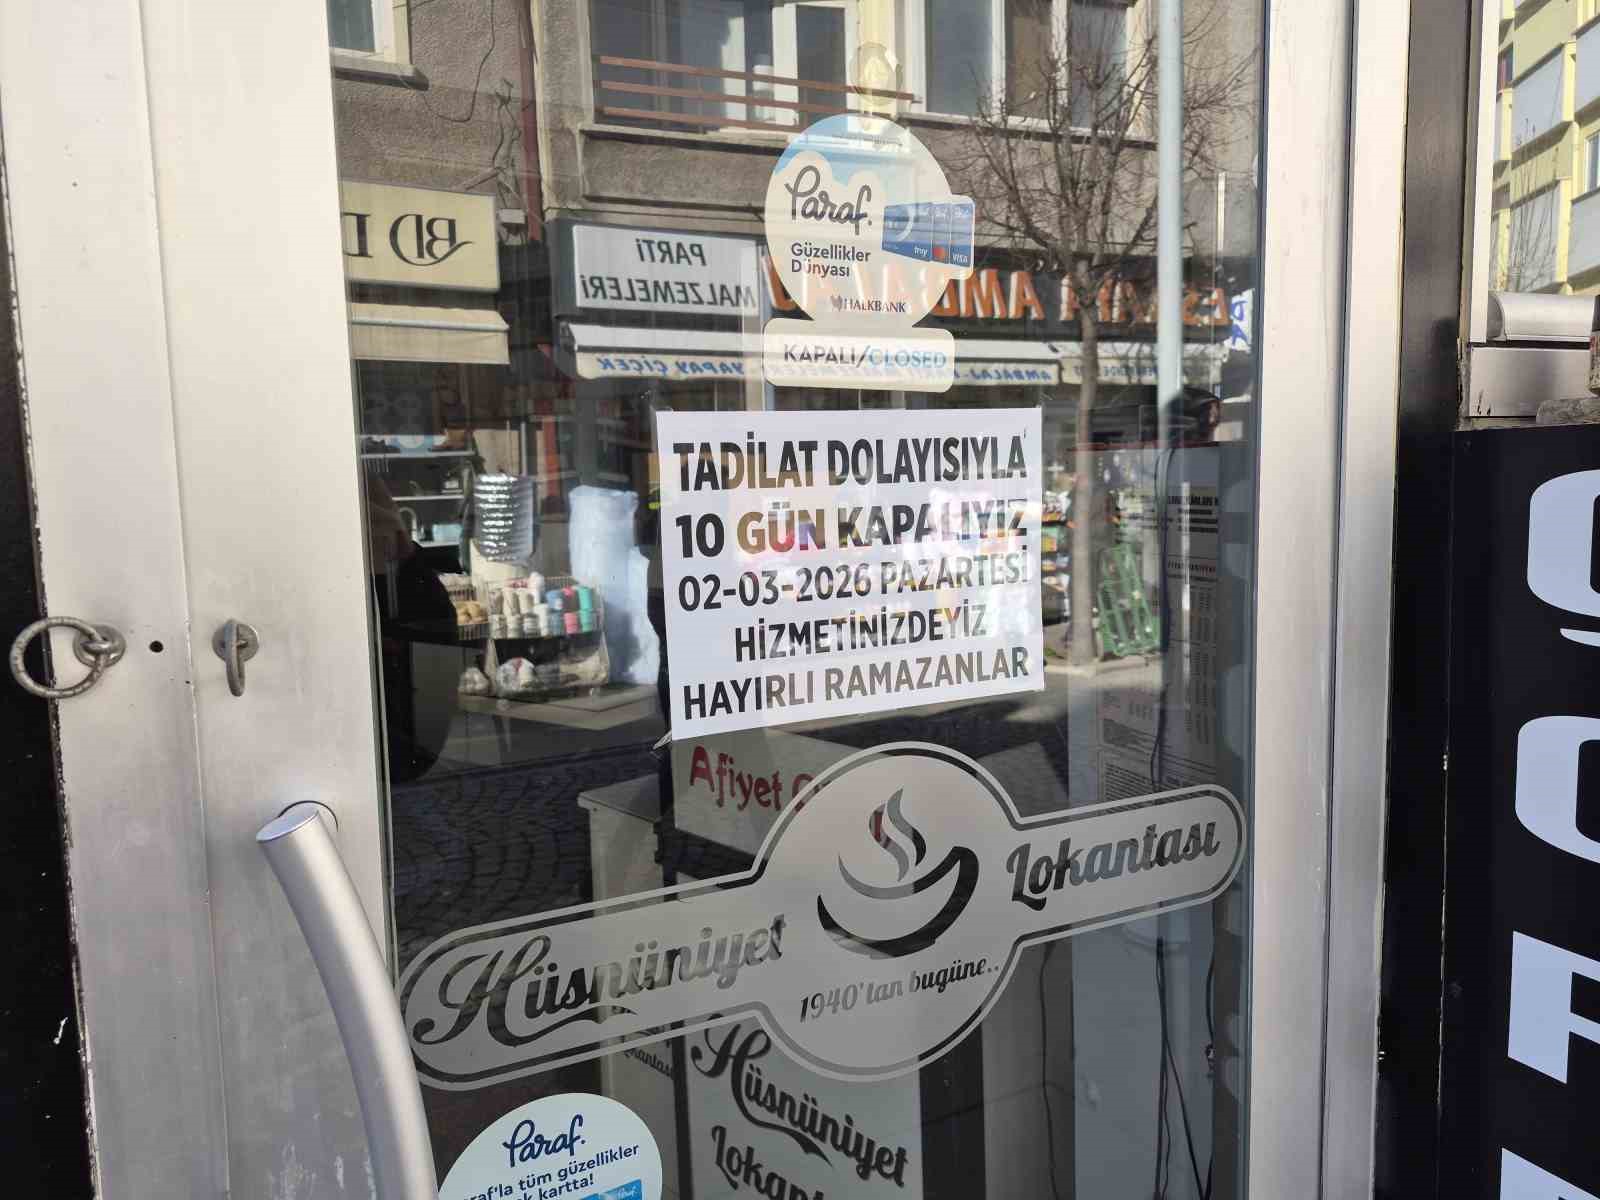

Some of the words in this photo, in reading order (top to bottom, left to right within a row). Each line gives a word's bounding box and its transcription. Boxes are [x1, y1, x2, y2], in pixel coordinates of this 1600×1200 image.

[791, 242, 871, 262] Güzellikler
[792, 259, 850, 278] Dünyası
[843, 298, 906, 313] HALKBANK
[673, 432, 818, 491] TADİLAT
[828, 435, 1027, 486] DOLAYISIYLA
[676, 513, 725, 558] 10
[737, 501, 826, 554] GÜN
[838, 498, 1028, 548] KAPALIYIZ
[678, 562, 872, 611] 02-03-2026
[881, 545, 1029, 595] PAZARTESİ
[735, 599, 987, 662] HİZMETİNİZDEYİZ
[684, 671, 814, 720] HAYIRLI
[825, 646, 1029, 702] RAMAZANLAR
[690, 745, 783, 811] Afiyet
[413, 914, 787, 1047] Hüsnüniyet
[1006, 822, 1221, 911] Lokantası
[691, 1013, 908, 1188] Hüsnüniyet
[518, 1173, 552, 1191] tüm
[558, 1145, 639, 1181] güzellikler
[538, 1174, 594, 1200] kartta!
